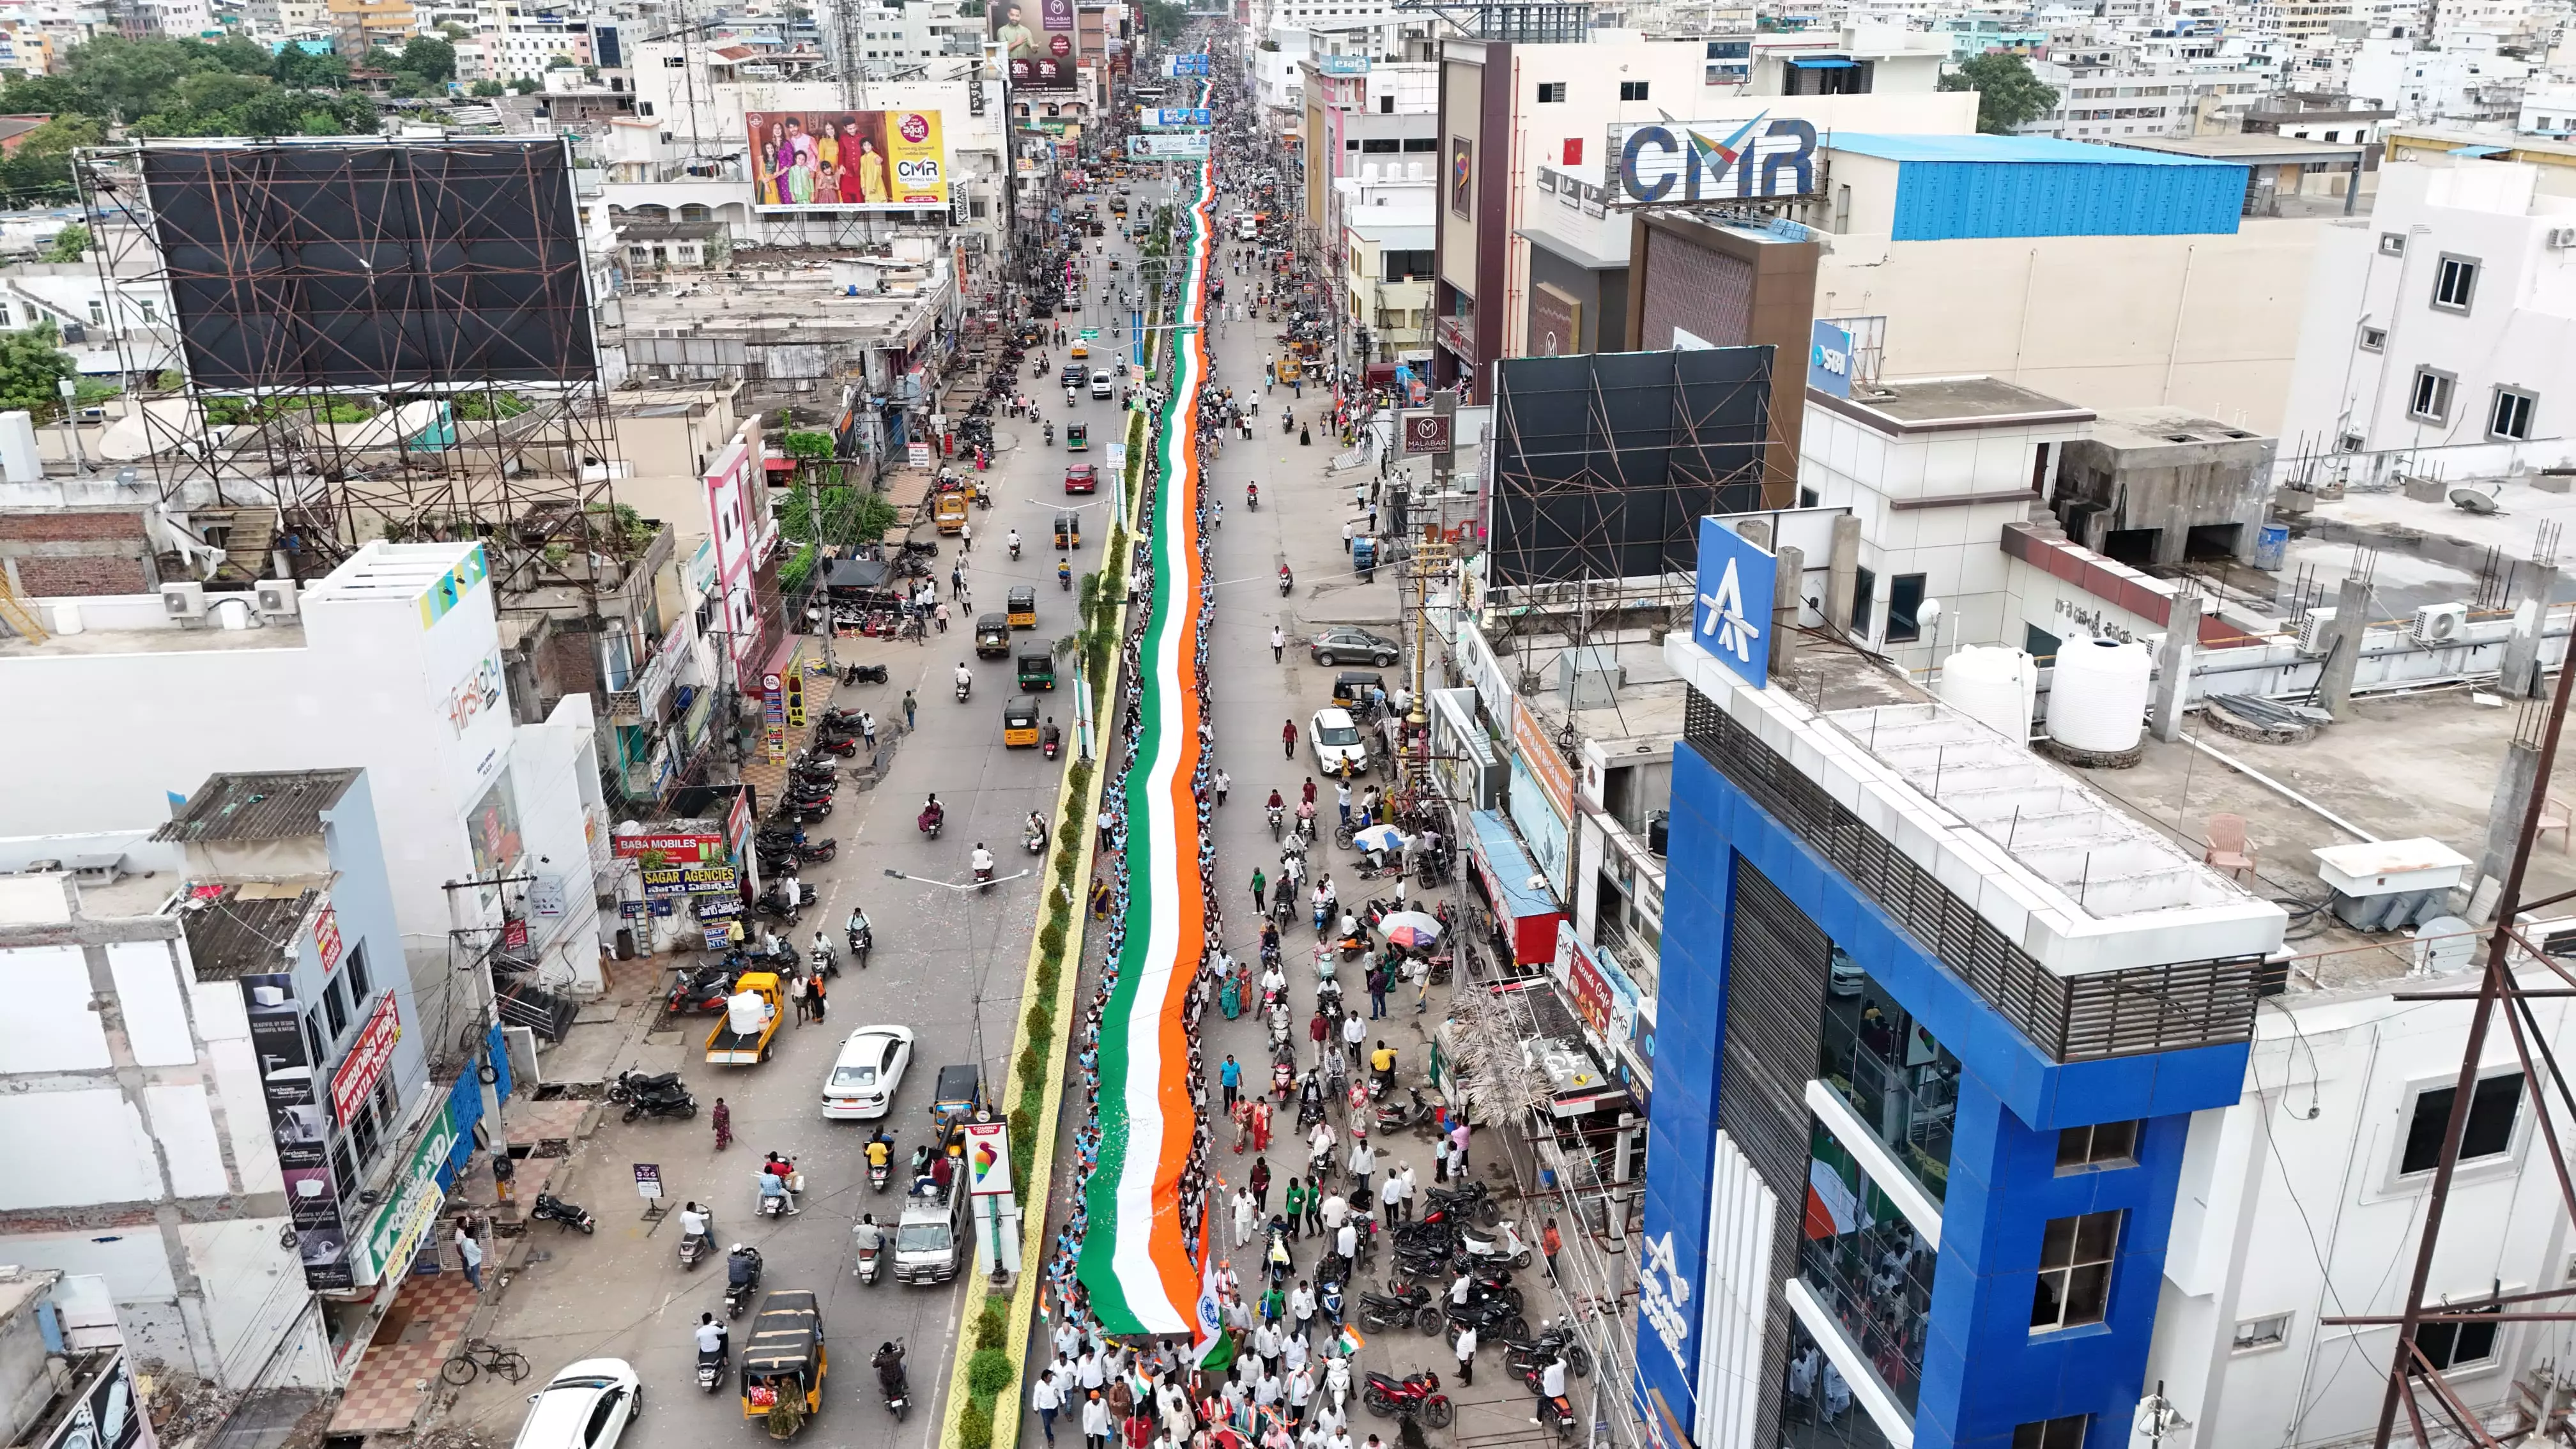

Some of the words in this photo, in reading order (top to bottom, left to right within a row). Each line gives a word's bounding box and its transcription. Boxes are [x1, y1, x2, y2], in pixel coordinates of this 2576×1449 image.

[1013, 64, 1028, 73] 30%
[1040, 64, 1055, 73] 30%
[898, 160, 938, 176] CMR
[1621, 109, 1816, 201] CMR
[958, 181, 968, 224] KHAZANA
[1824, 349, 1846, 375] SBI
[450, 653, 502, 741] firstcry
[1521, 719, 1542, 759] POPULAR
[1542, 750, 1554, 780] SHOE
[1554, 769, 1570, 801] MART
[621, 840, 649, 849] BABA
[651, 839, 696, 848] MOBILES
[645, 871, 680, 884] SAGAR
[684, 868, 735, 883] AGENCIES
[323, 935, 339, 962] AJANTA
[326, 945, 341, 969] LODGE
[708, 939, 727, 948] NTN
[1558, 933, 1572, 960] CMR
[1574, 950, 1595, 989] Friends
[1611, 1005, 1628, 1035] CMR
[343, 1076, 372, 1126] AJANTA
[372, 1034, 394, 1078] LODGE
[1630, 1075, 1644, 1105] SBI
